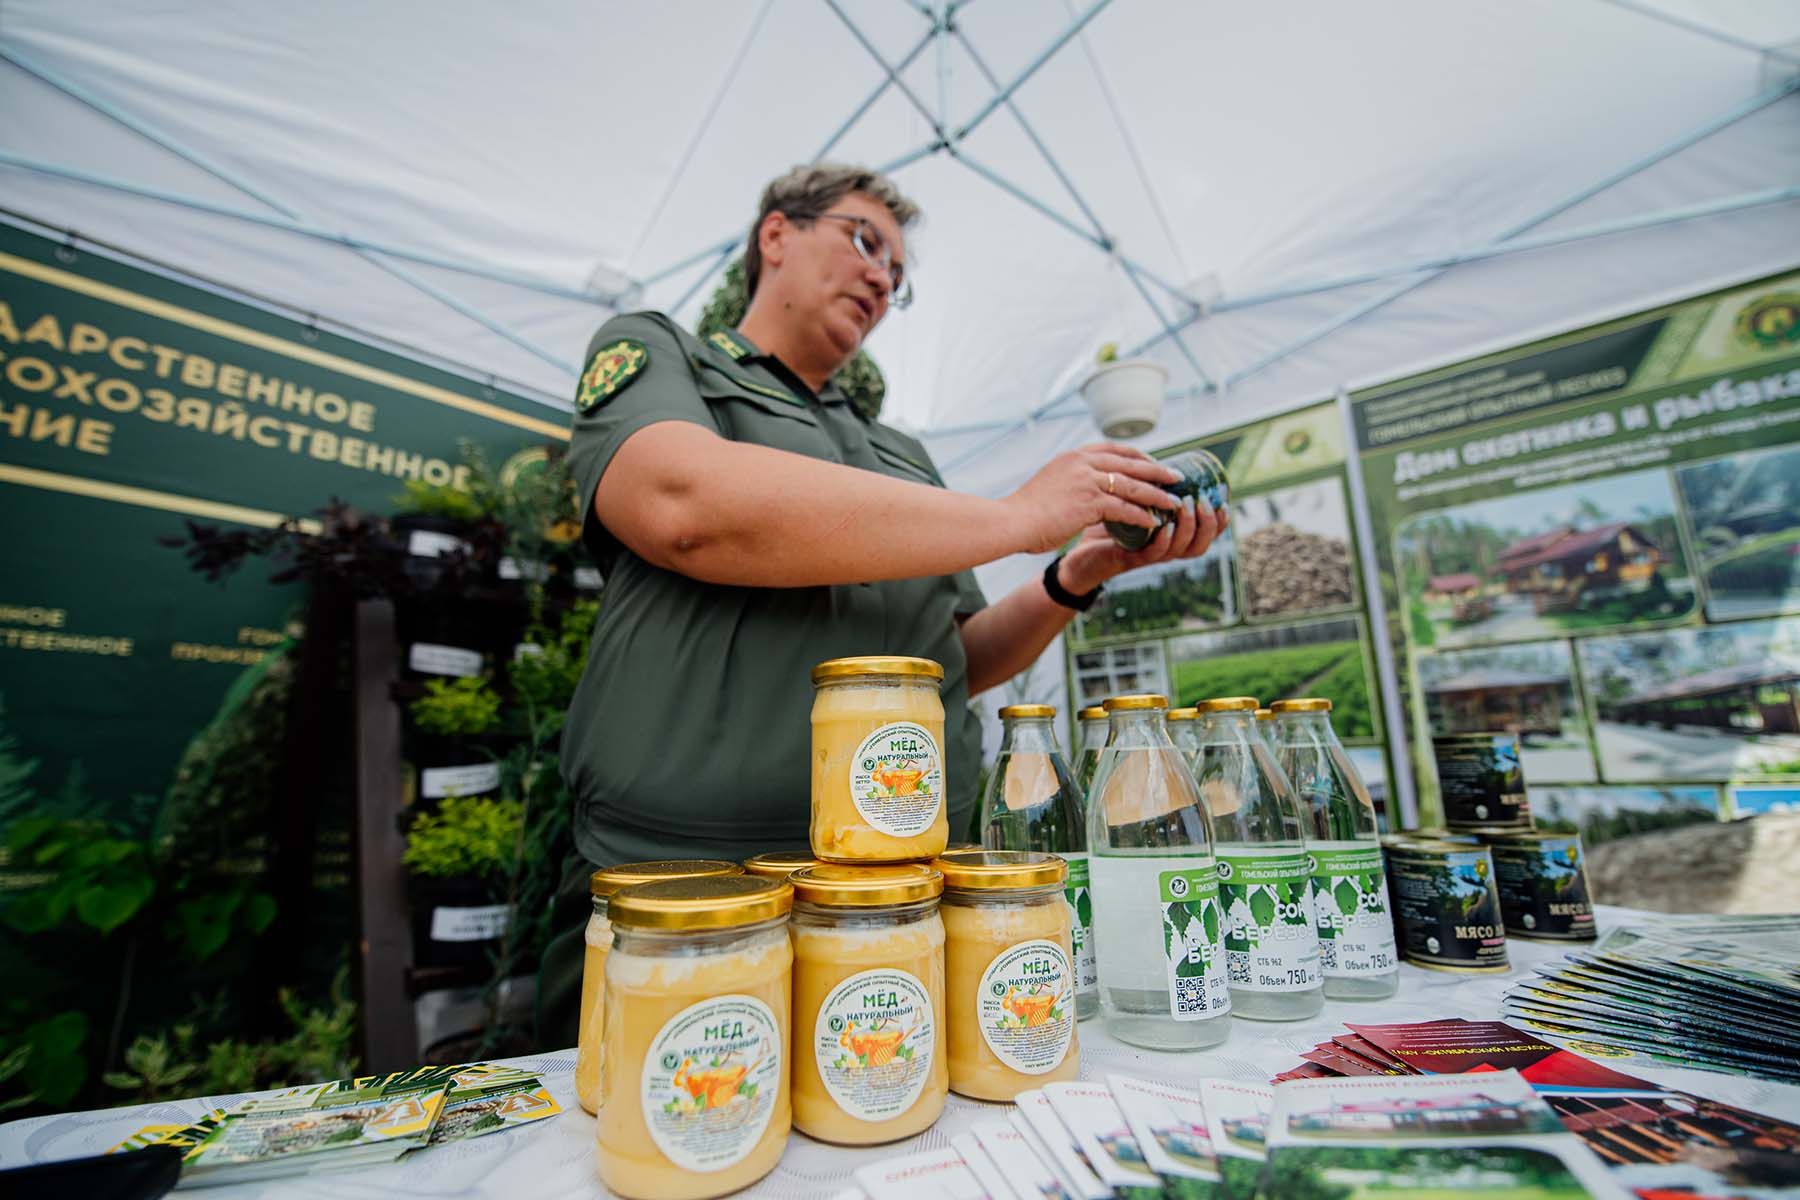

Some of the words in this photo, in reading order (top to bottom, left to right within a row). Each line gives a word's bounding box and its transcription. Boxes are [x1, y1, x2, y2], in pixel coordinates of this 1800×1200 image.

[1394, 447, 1458, 486] Дом
[1461, 411, 1617, 465] охотника
[1620, 403, 1649, 431] и
[890, 737, 918, 752] МЁД
[877, 751, 929, 762] НАТУРАЛЬНЫЙ
[1455, 926, 1494, 939] МЯСО
[1022, 957, 1051, 976] МЁД
[1257, 957, 1270, 967] СТБ
[1271, 957, 1283, 967] 962
[1371, 953, 1387, 969] 750
[1008, 972, 1062, 987] НАТУРАЛЬНЫЙ
[1259, 974, 1287, 986] Объем
[1287, 968, 1307, 985] 750
[863, 989, 898, 1009] МЁД
[846, 1004, 913, 1021] НАТУРАЛЬНЫЙ
[704, 1018, 744, 1041] МЁД
[683, 1034, 760, 1057] НАТУРАЛЬНЫЙ
